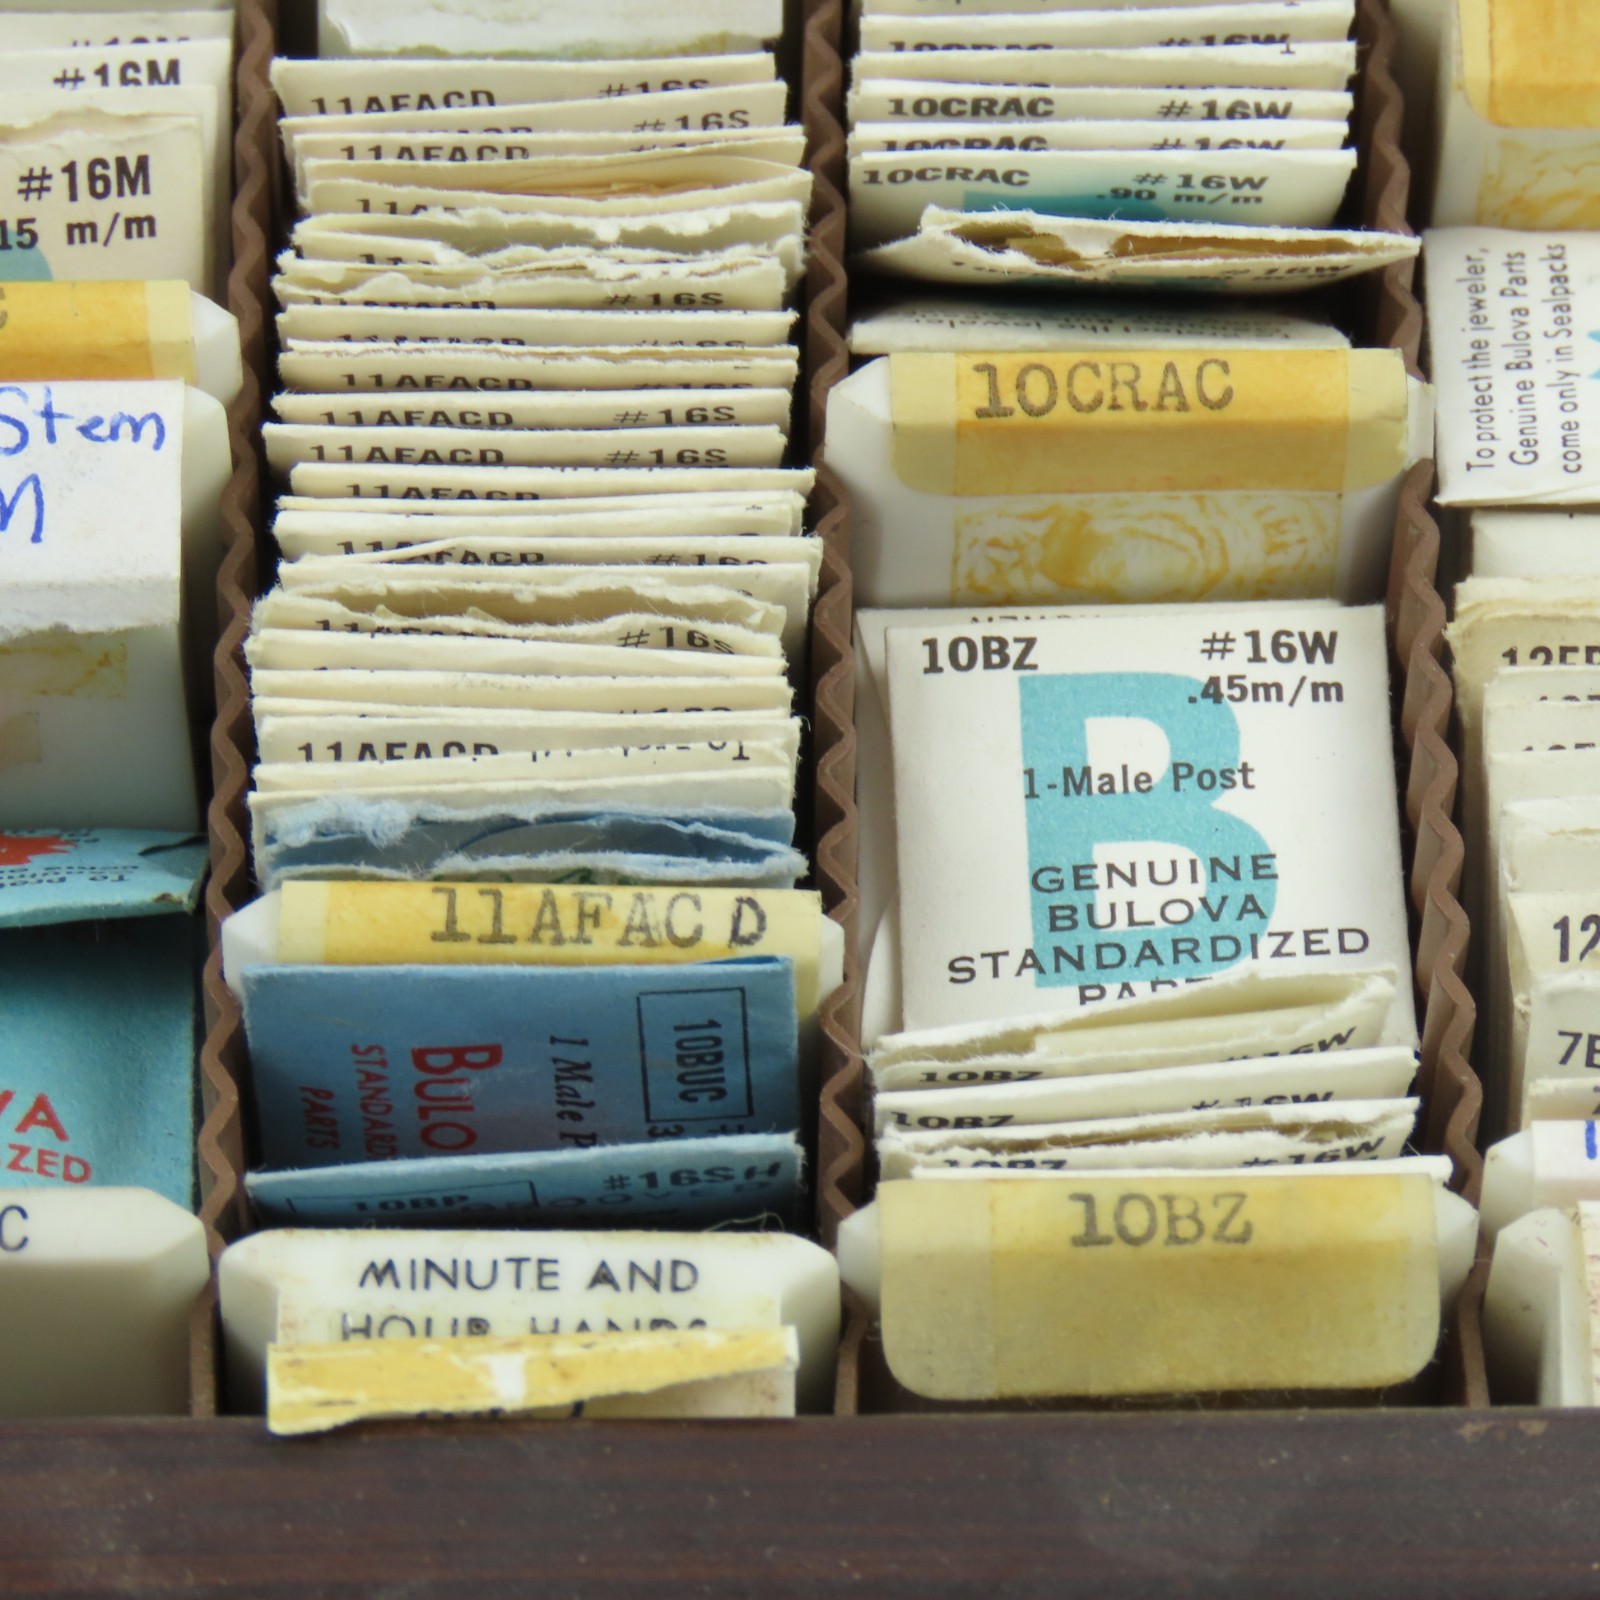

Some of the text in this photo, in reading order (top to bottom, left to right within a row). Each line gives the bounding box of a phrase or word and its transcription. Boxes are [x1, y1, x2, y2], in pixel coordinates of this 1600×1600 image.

[888, 97, 1293, 120] 10CRAC #16W
[18, 154, 151, 202] #16M
[862, 167, 1269, 191] 10CRAC #16W
[1461, 338, 1492, 371] the
[1499, 251, 1540, 466] Genuine Bulova Parts
[1538, 243, 1583, 474] come only in Sealpacks
[971, 361, 1235, 419] 10CRAC
[1468, 375, 1502, 442] protect
[319, 406, 737, 427] 11AFACD #16S
[310, 445, 728, 465] 11AFACD #16S
[1466, 446, 1496, 472] To
[922, 629, 1339, 675] 10BZ #16W
[1172, 761, 1256, 793] Post
[1031, 853, 1280, 894] GENUINE
[1047, 893, 1268, 933] BULOVA
[947, 927, 1371, 985] STANDARDIZED
[673, 1018, 728, 1104] 10BUC
[1067, 1191, 1254, 1248] 10BZ
[358, 1256, 700, 1293] MINUTE AND
